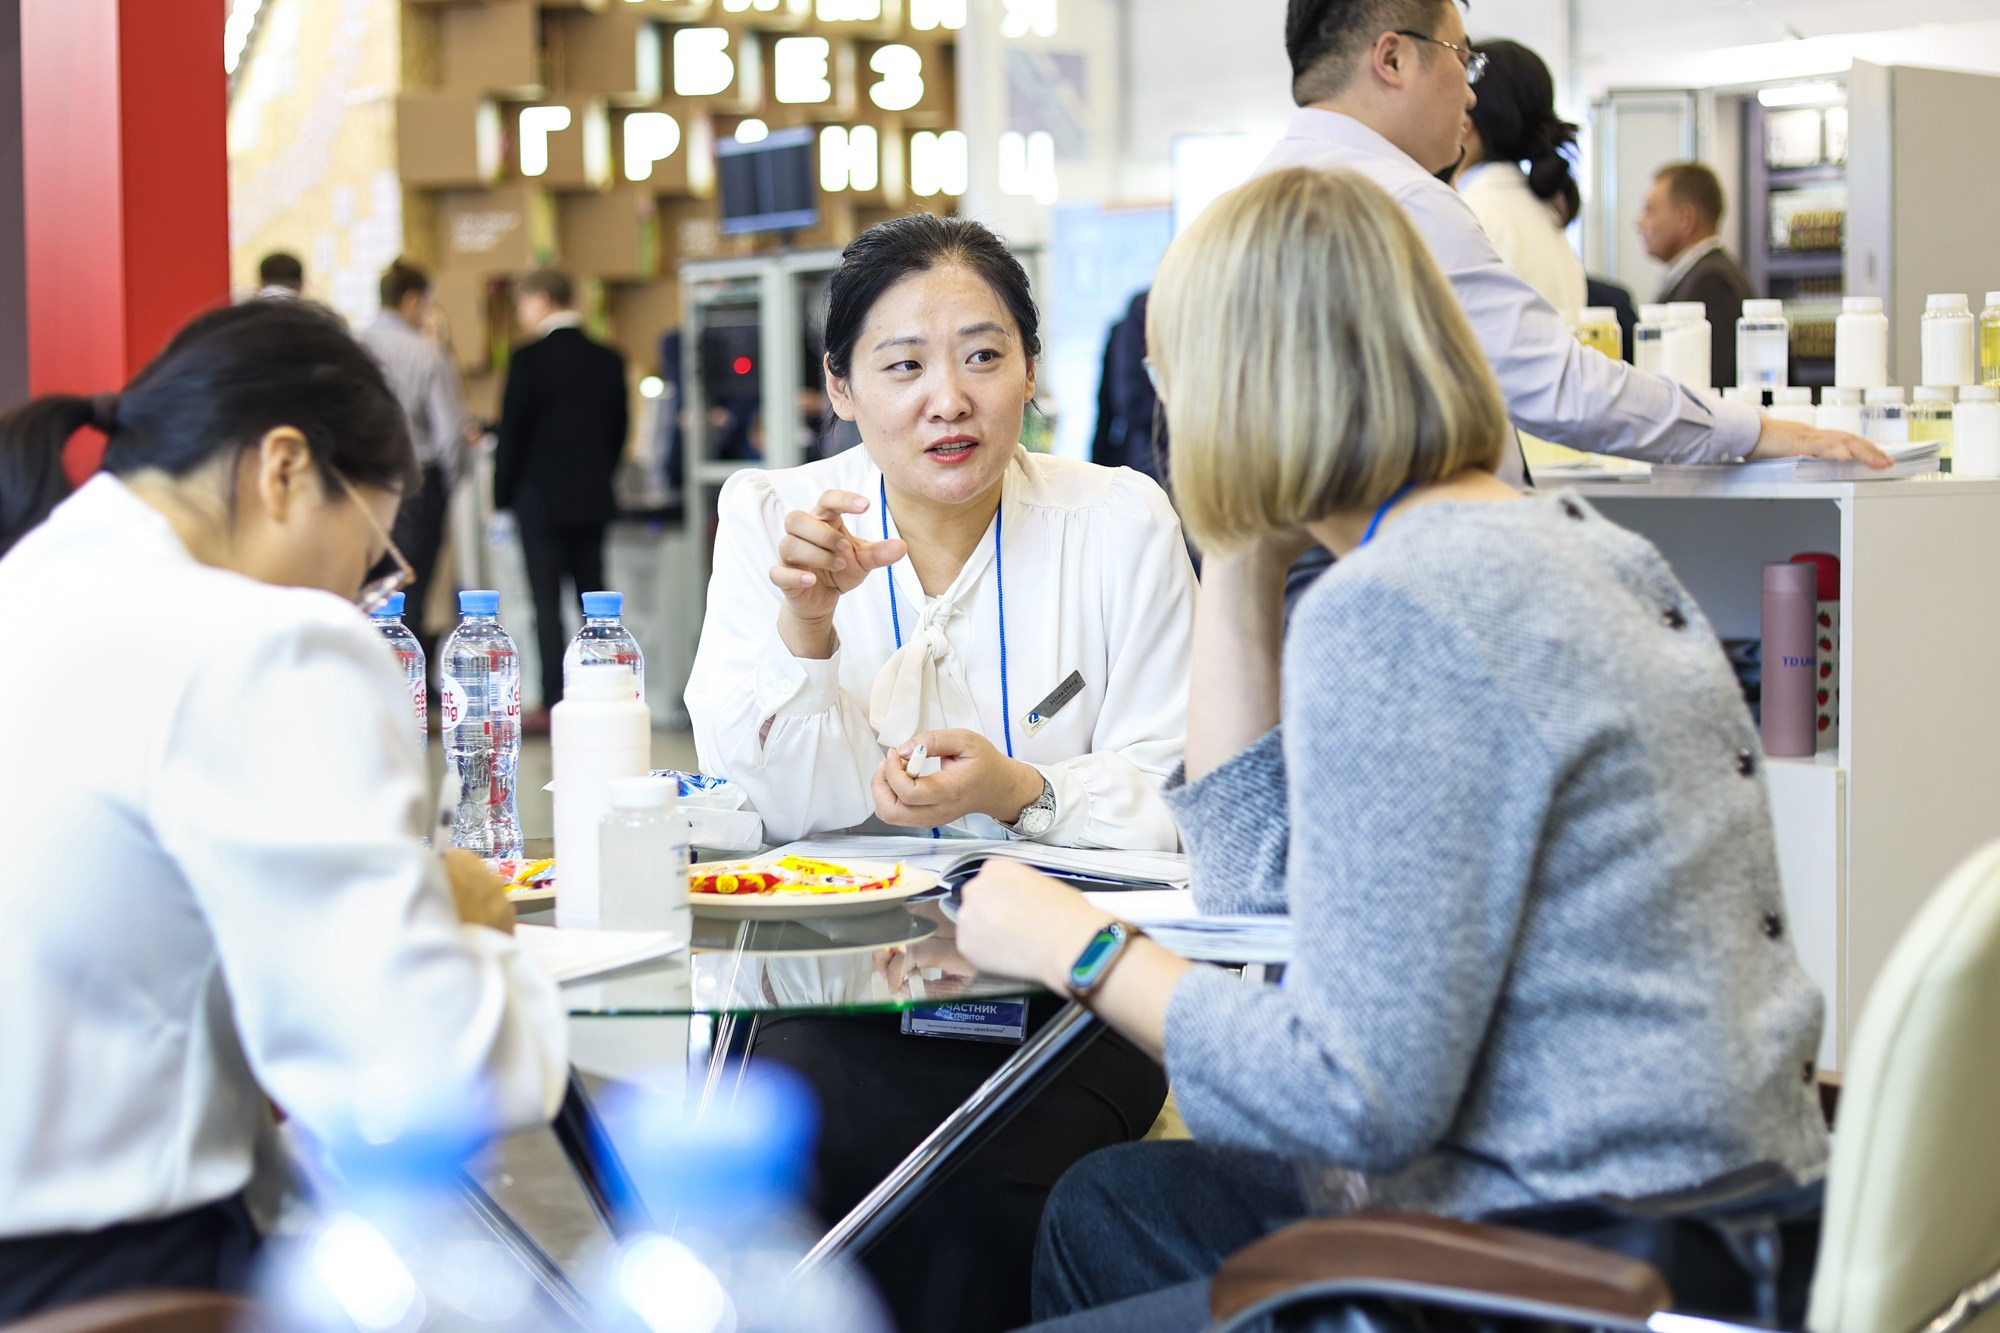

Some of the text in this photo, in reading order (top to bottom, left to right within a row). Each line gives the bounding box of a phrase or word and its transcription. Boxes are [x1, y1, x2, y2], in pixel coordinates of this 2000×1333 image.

[674, 28, 924, 111] БЕЗ
[939, 1003, 998, 1014] УЧАСТНИК
[949, 1012, 986, 1021] EXHIBITOR
